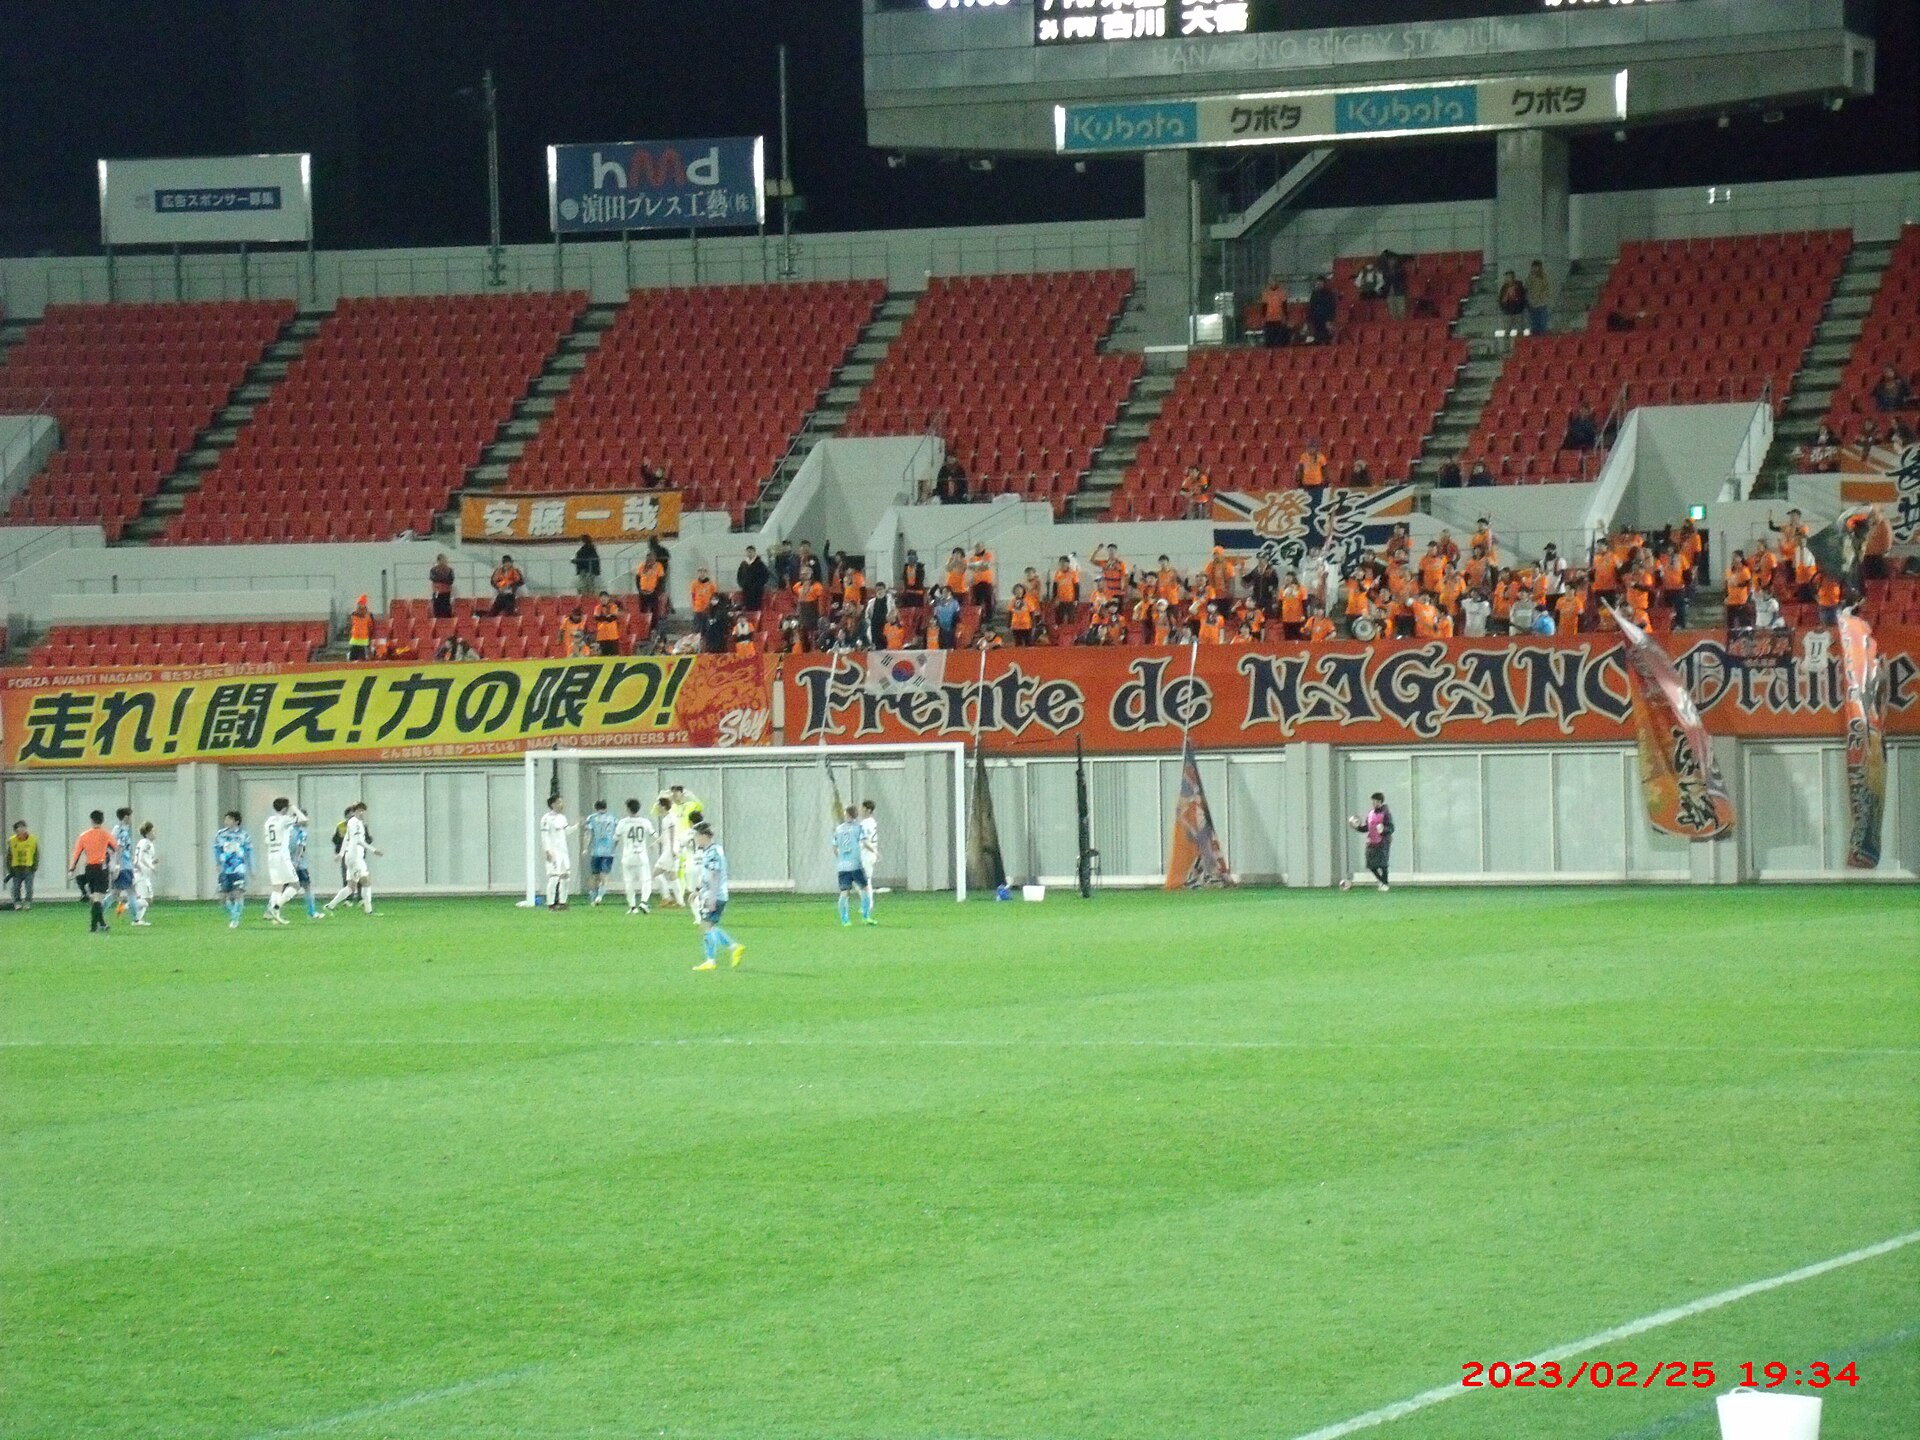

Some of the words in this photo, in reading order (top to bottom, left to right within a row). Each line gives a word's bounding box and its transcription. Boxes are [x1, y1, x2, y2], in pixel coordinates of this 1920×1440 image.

[1153, 37, 1298, 66] HANAZONO
[1307, 32, 1394, 60] RUGBY
[1402, 22, 1521, 53] STADIUM
[1073, 112, 1186, 142] Kubota
[1230, 104, 1301, 133] クボタ
[1346, 94, 1466, 126] Kubota
[1511, 86, 1588, 117] クボタ
[8, 675, 50, 690] FORZA
[51, 673, 97, 687] AVANTI
[100, 671, 153, 684] NAGANO
[1110, 655, 1213, 733] de
[526, 735, 579, 748] NAGANO
[580, 731, 666, 746] SUPPORTERS
[667, 730, 689, 743] #12
[268, 824, 277, 841] 6
[627, 826, 645, 843] 40
